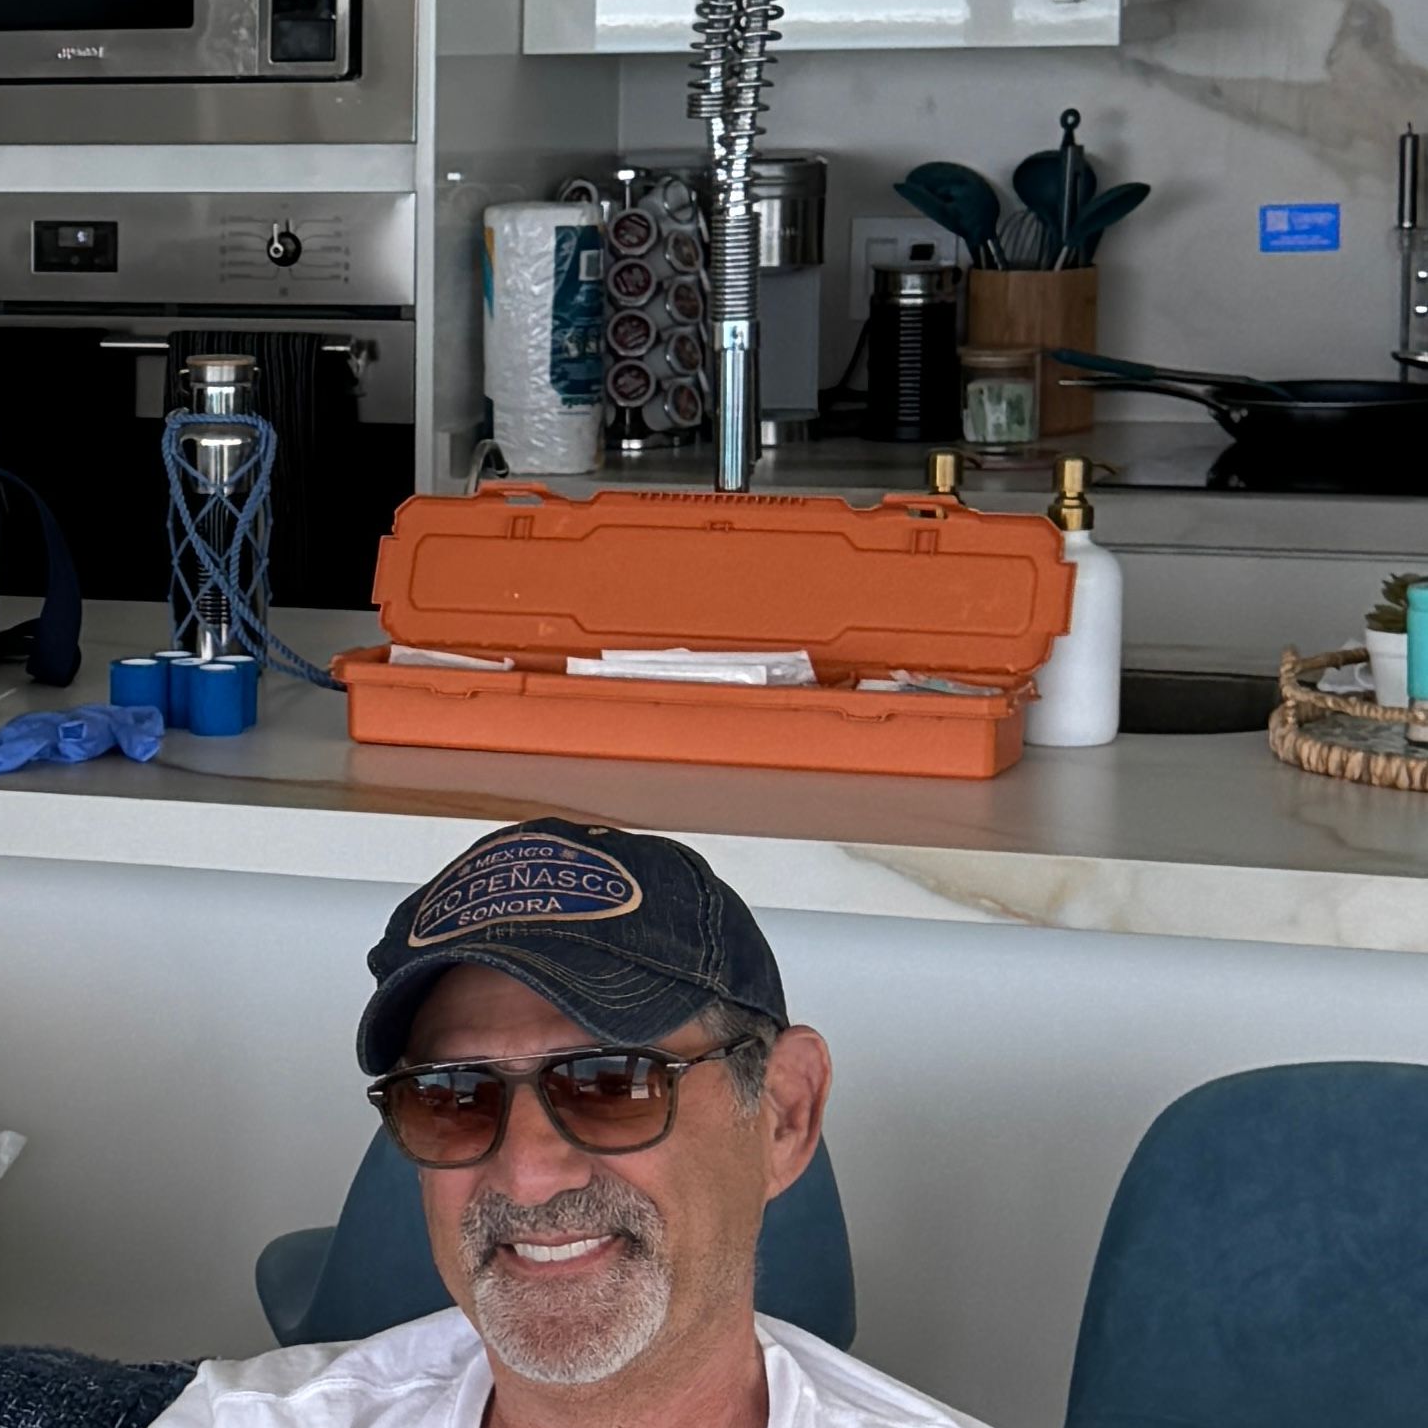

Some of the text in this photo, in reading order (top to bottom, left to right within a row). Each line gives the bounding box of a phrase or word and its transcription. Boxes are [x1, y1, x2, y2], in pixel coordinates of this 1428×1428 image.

[475, 846, 553, 869] MEXICO
[468, 862, 627, 901] PEÑASCO
[457, 896, 563, 927] SONORA
